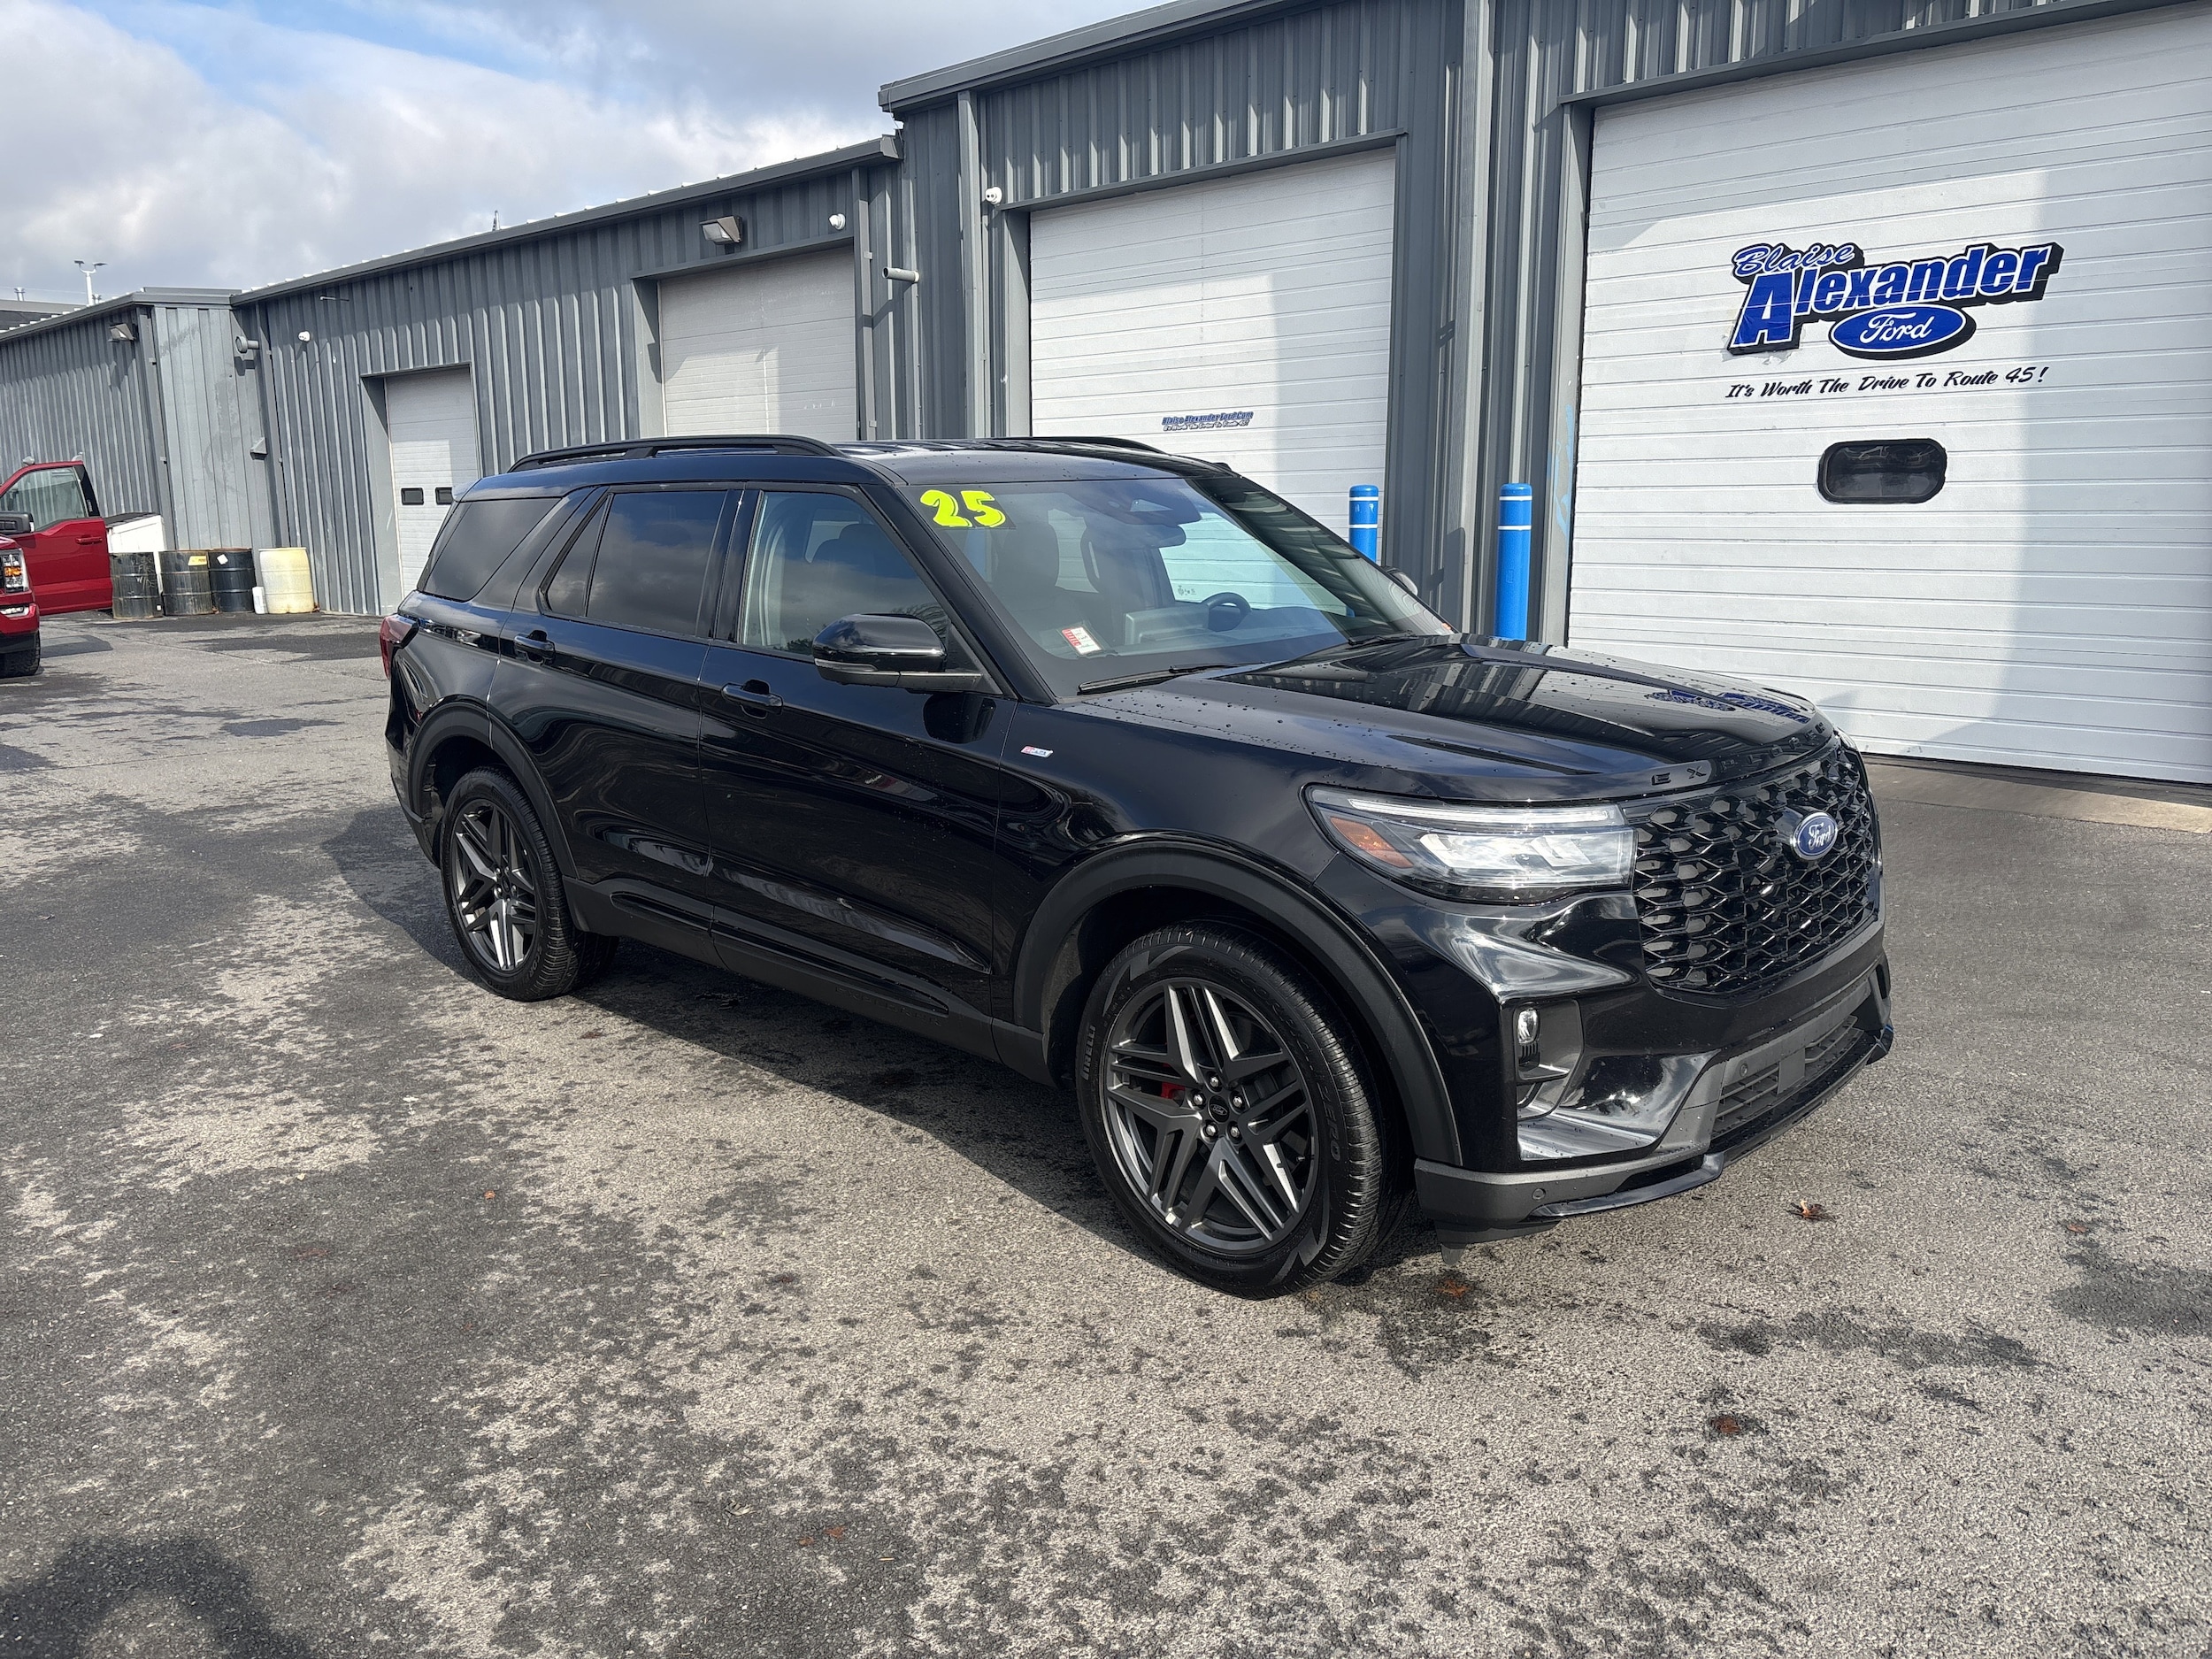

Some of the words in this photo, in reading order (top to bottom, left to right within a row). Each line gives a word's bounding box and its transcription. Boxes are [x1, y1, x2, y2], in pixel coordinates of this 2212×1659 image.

[1734, 243, 1855, 276] Blaise
[1730, 244, 2050, 347] Alexander
[1859, 312, 1932, 343] Ford
[1725, 384, 1754, 398] It's
[1761, 380, 1813, 396] Worth
[1815, 379, 1850, 394] The
[1858, 374, 1909, 391] Drive
[1916, 373, 1937, 388] To
[1944, 370, 2000, 387] Route
[919, 489, 1007, 528] 25
[1808, 822, 1832, 850] Ford
[1082, 1025, 1096, 1081] PIRELLI
